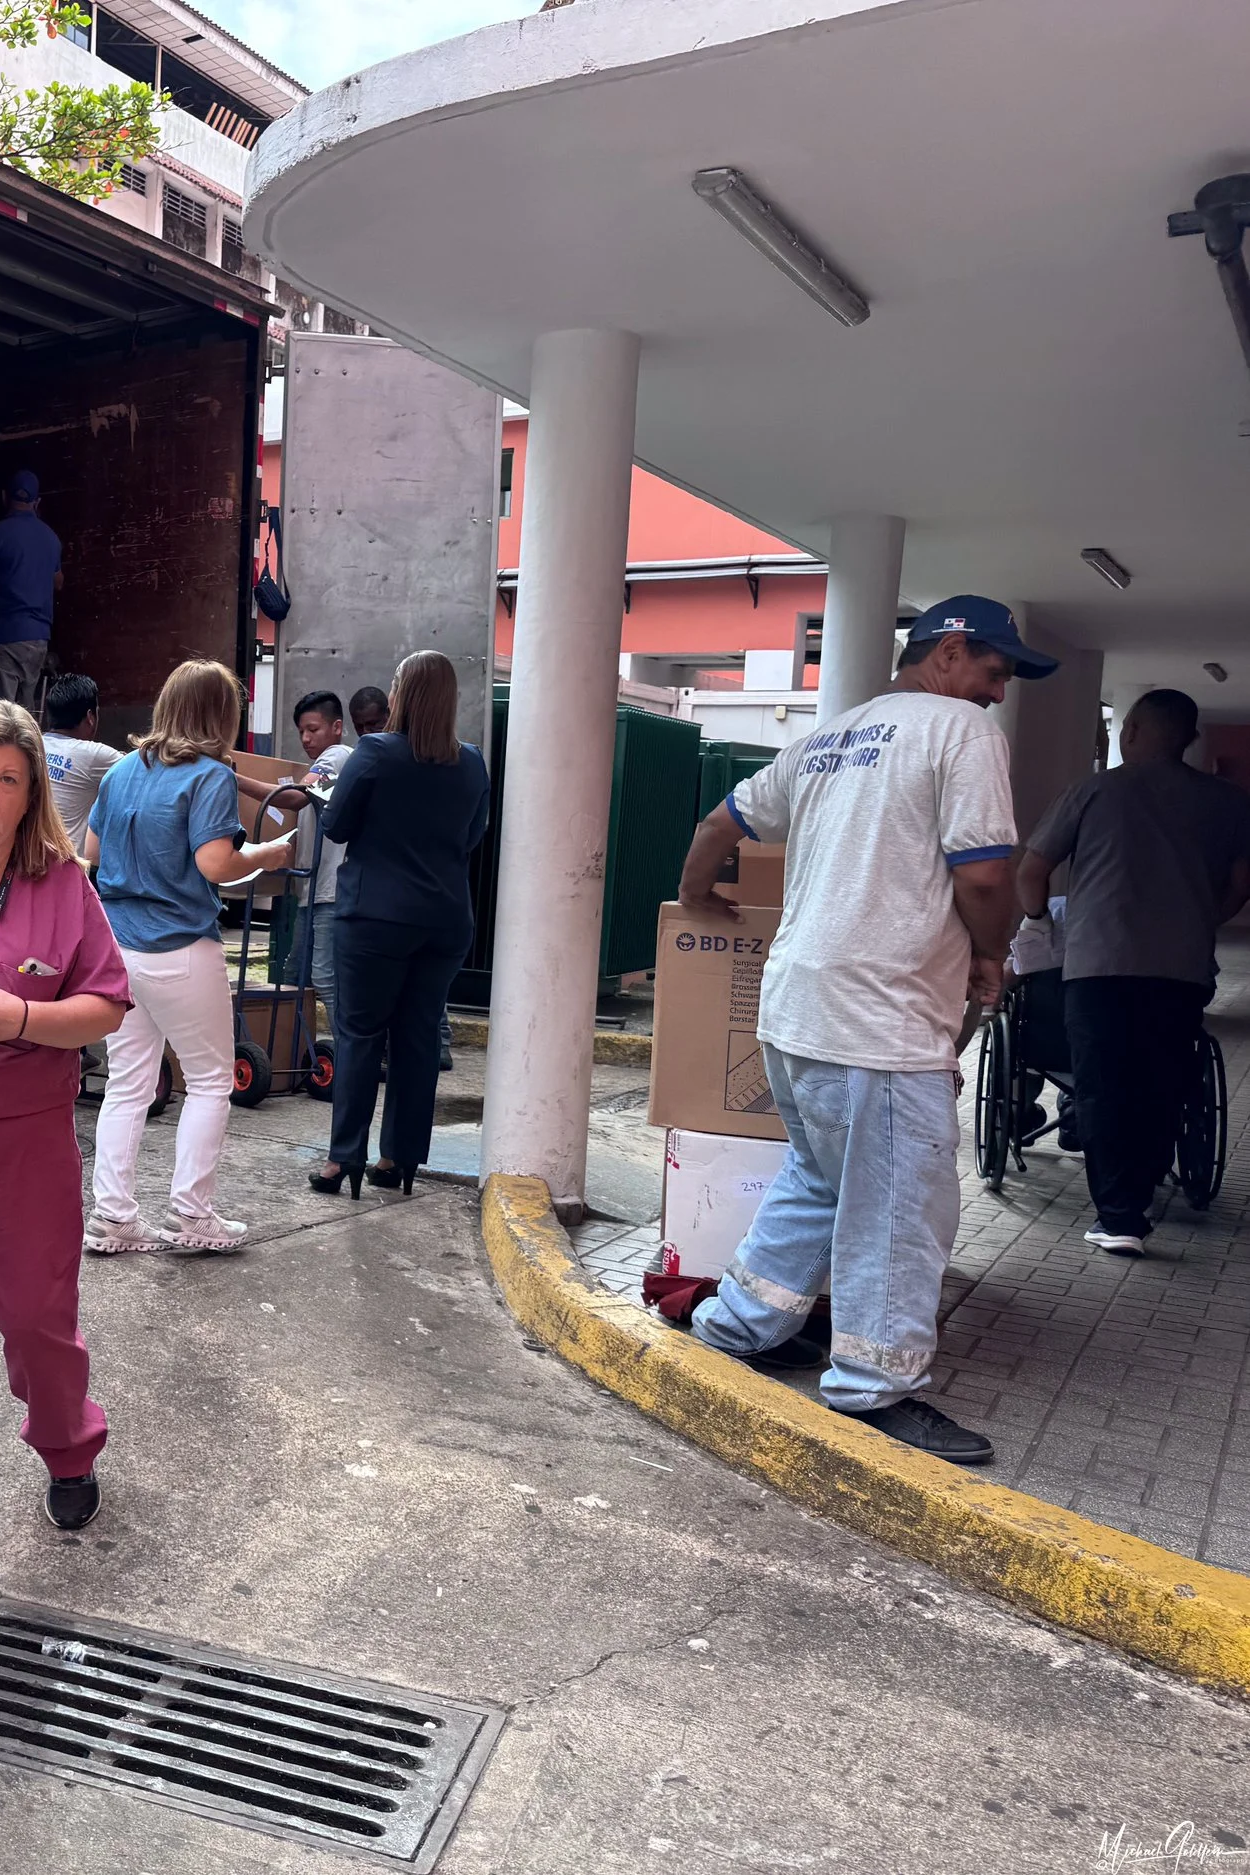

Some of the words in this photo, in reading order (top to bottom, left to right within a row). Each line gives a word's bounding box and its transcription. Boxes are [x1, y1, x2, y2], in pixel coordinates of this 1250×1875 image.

[882, 725, 897, 743] &
[64, 758, 73, 769] &
[700, 935, 728, 952] BD
[733, 938, 764, 954] E-Z
[741, 1181, 764, 1193] 297
